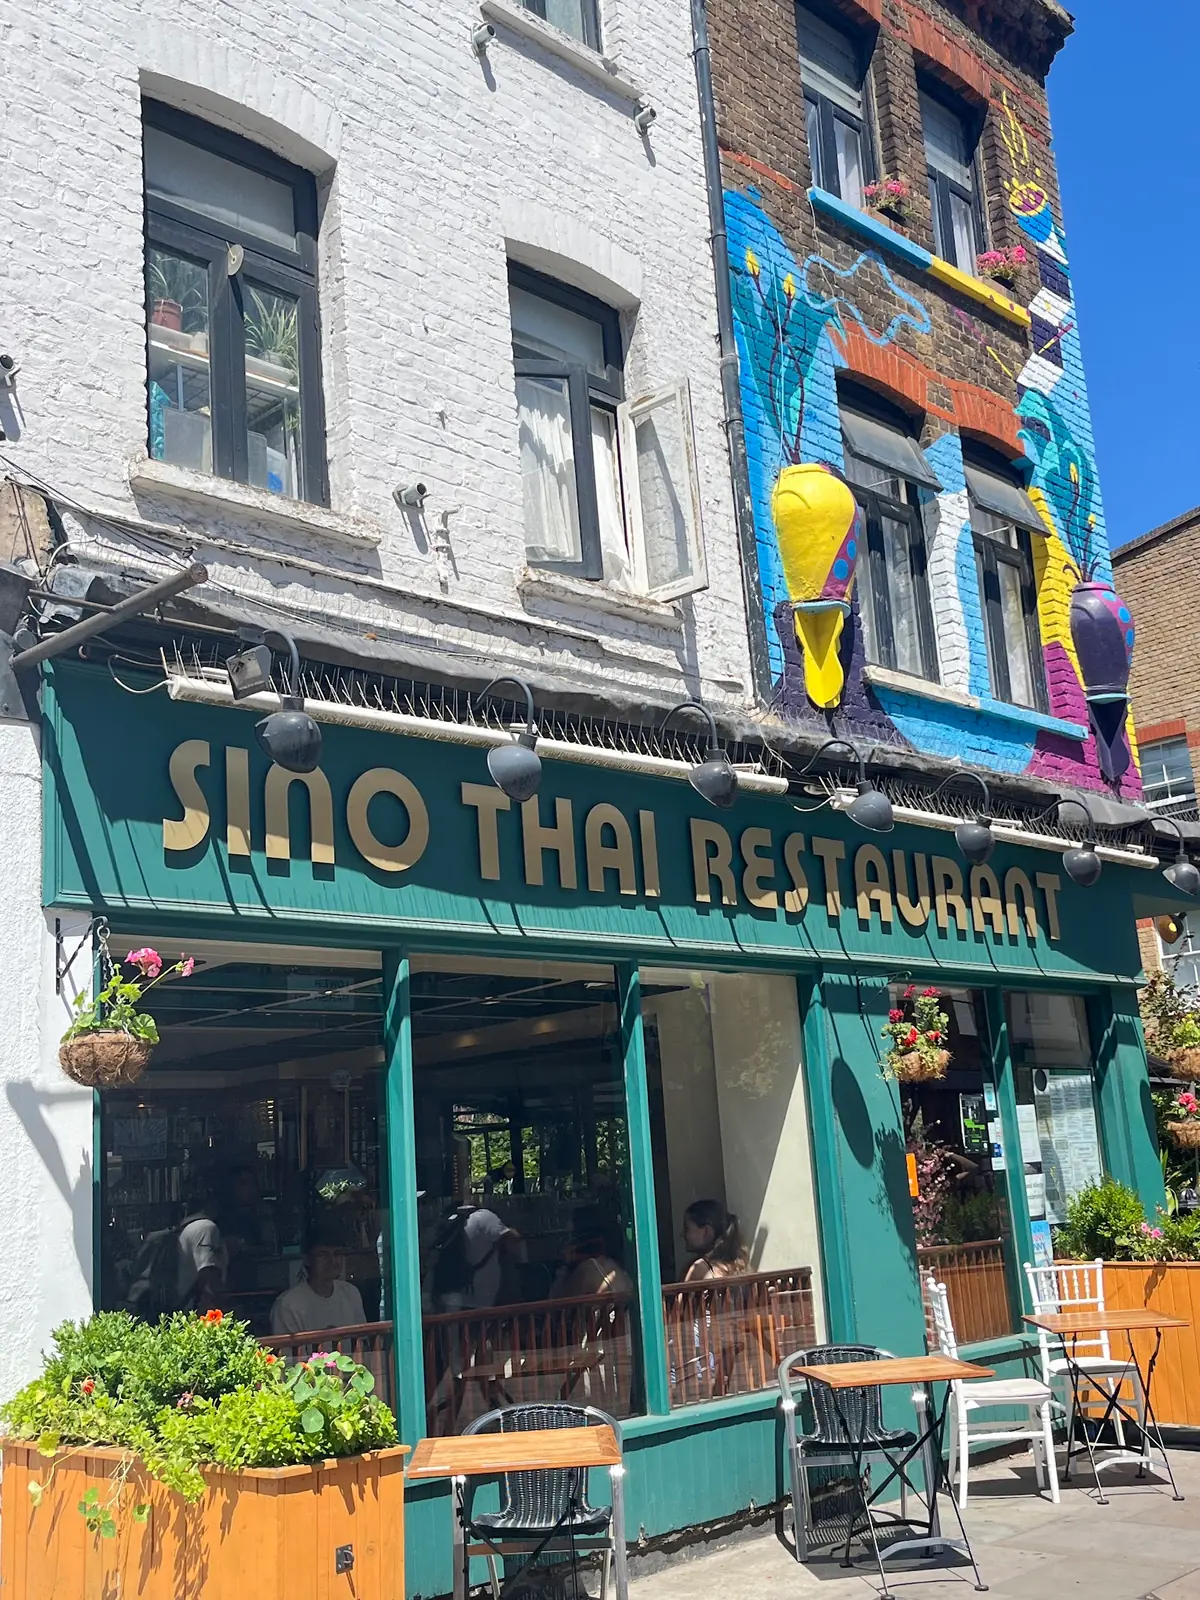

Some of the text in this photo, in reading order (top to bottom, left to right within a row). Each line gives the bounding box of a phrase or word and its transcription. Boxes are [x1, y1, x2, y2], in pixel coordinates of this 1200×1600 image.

[163, 739, 1061, 940] SINO THAI RESTAURANT
